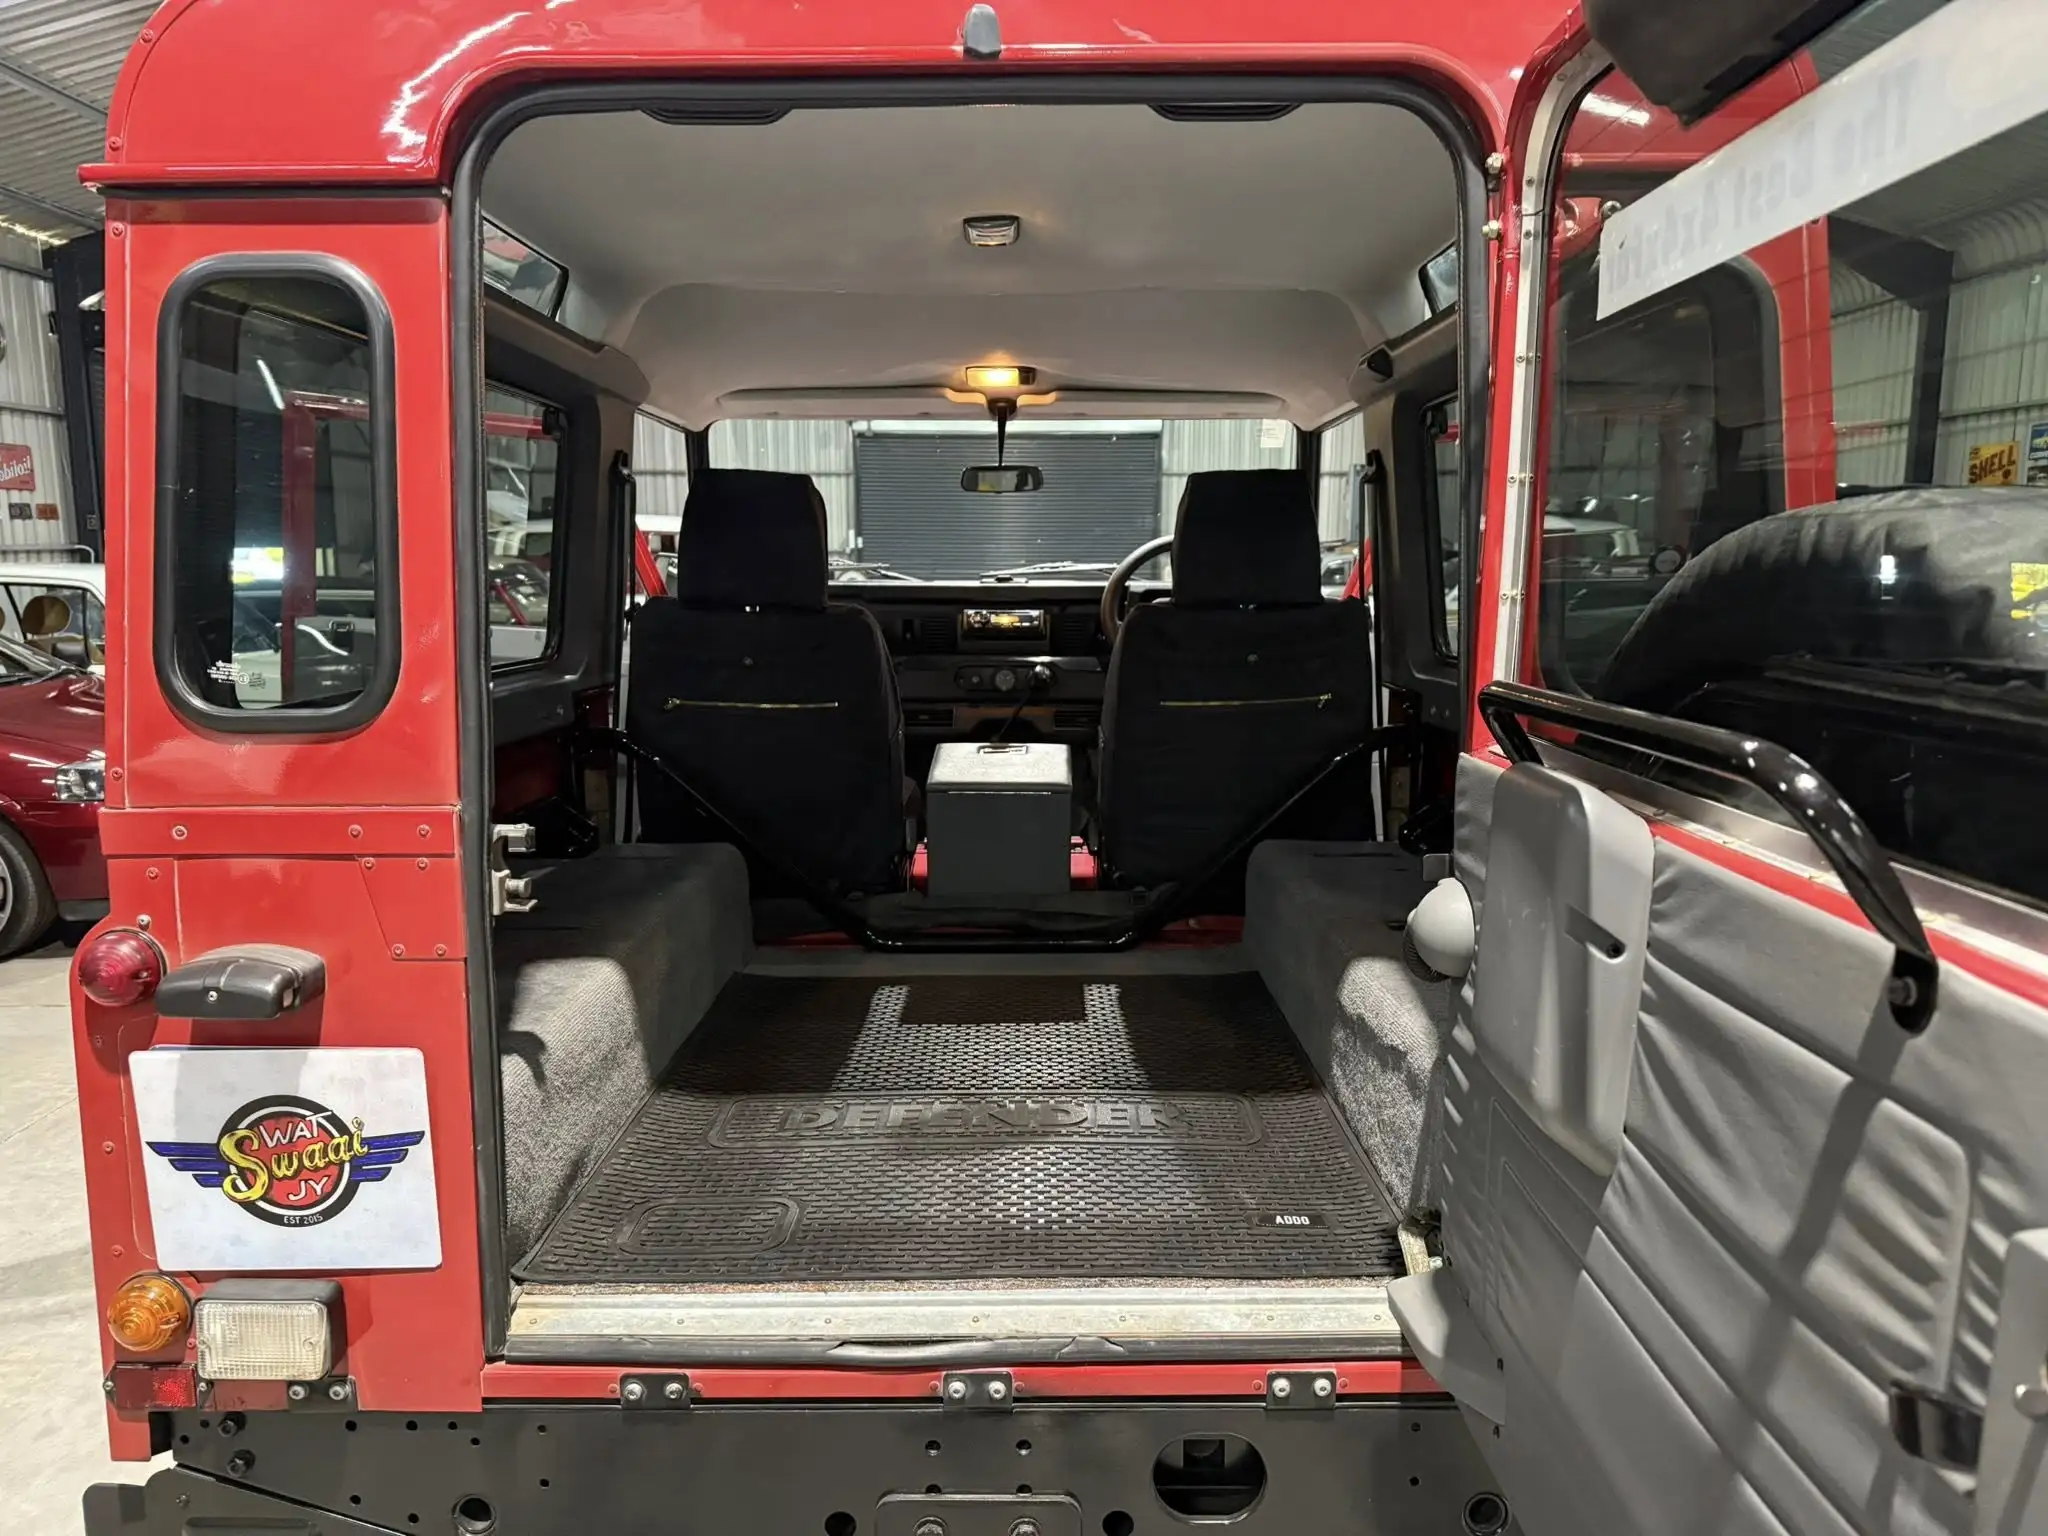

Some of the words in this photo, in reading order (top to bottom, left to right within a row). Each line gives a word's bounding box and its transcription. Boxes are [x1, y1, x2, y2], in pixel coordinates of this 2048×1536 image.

[0, 455, 30, 481] obiloil
[1969, 445, 2016, 484] SHELL
[260, 1110, 332, 1148] WAT
[782, 1100, 1194, 1130] DEFENDER
[219, 1116, 369, 1202] Swaai
[288, 1176, 330, 1201] JY
[284, 1215, 300, 1225] EST
[304, 1214, 324, 1225] 2015
